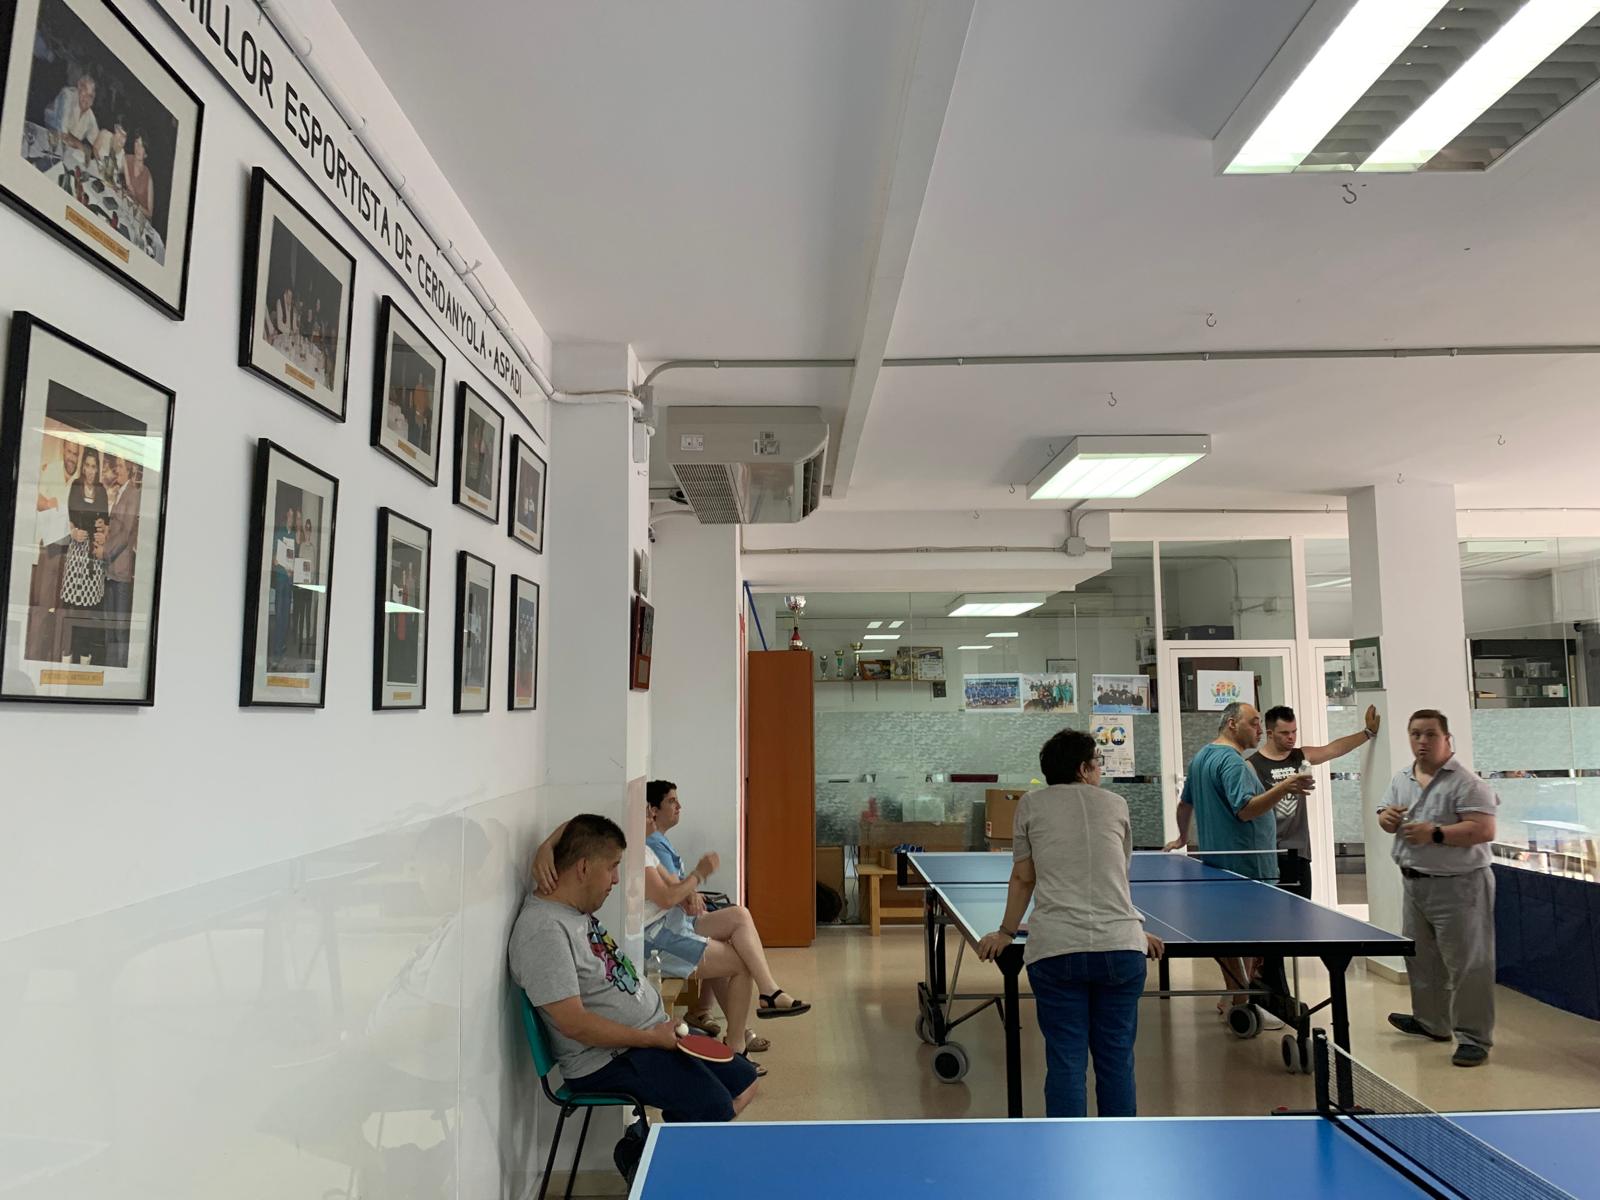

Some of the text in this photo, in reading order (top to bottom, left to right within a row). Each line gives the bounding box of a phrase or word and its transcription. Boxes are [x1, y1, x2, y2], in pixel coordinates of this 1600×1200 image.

[182, 0, 522, 398] ILLOR ESPORTISTA DE CERDANYOLA ASPADI
